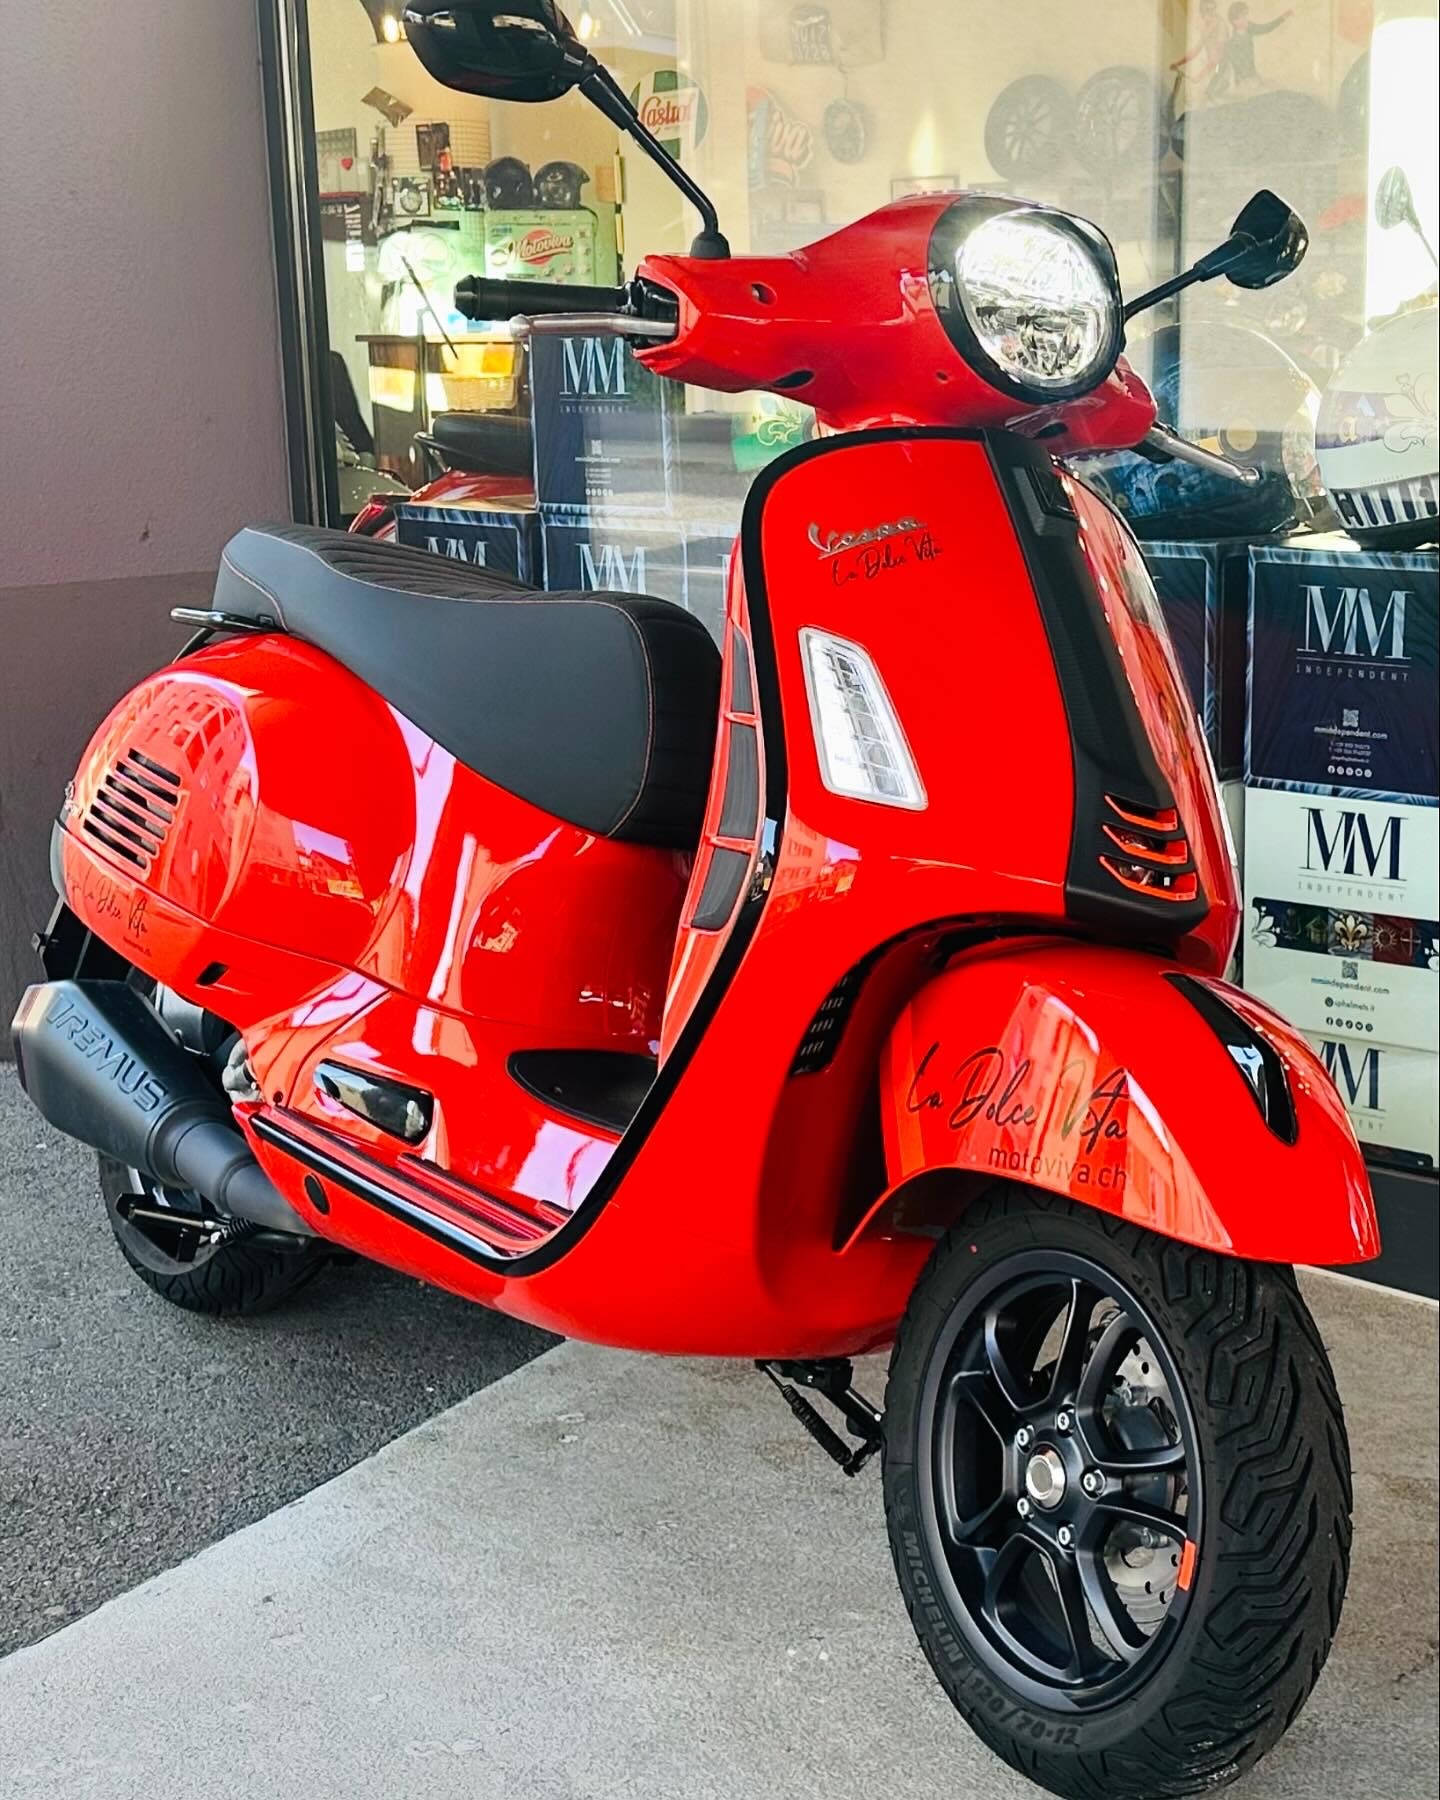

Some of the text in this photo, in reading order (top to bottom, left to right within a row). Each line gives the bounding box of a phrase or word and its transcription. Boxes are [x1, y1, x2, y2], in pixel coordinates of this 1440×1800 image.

[560, 337, 631, 395] MM
[1296, 585, 1414, 660] MM
[1296, 664, 1408, 681] INDEPENDENT
[1298, 806, 1408, 882] MM
[1297, 881, 1406, 904] INDEPENDENT
[46, 1002, 169, 1113] REMUS
[906, 1041, 1128, 1155] La Dolce Vita
[987, 1147, 1127, 1192] motoviva.ch
[904, 1531, 962, 1662] MICHELIN
